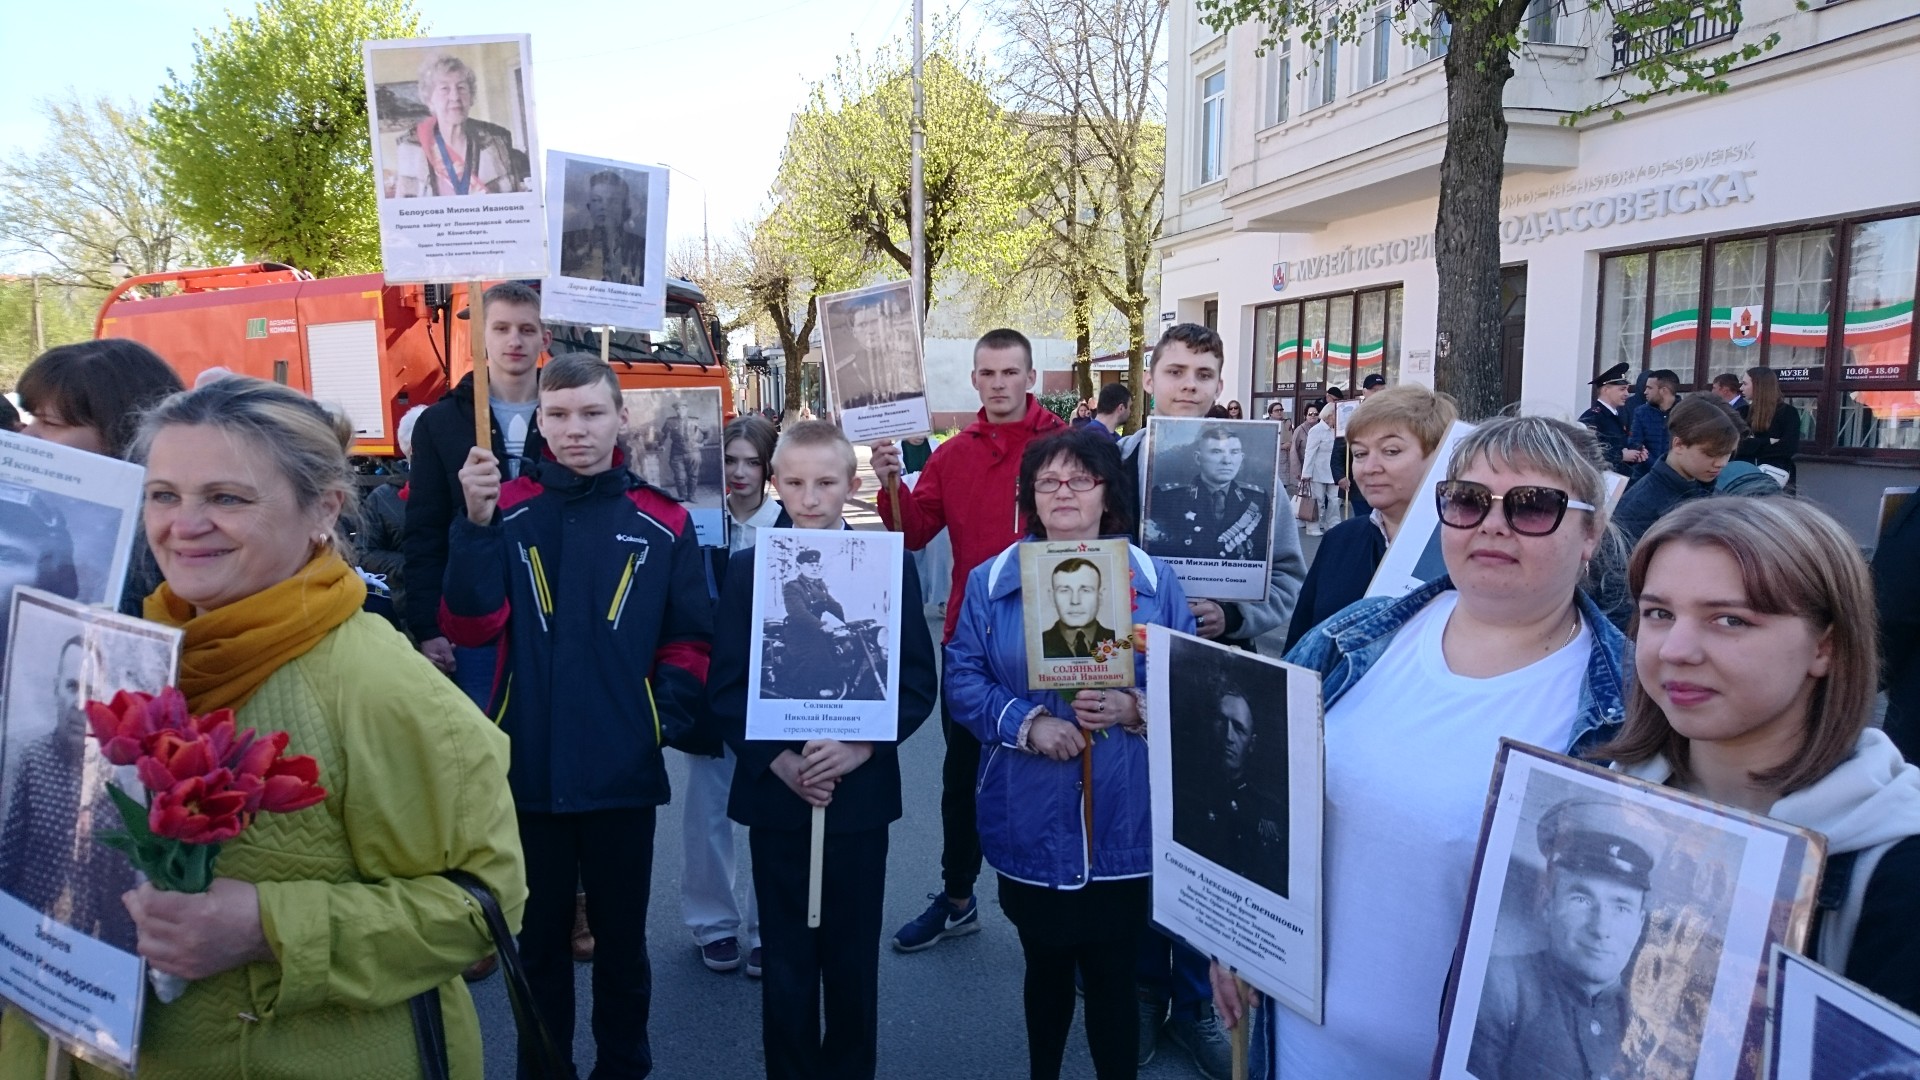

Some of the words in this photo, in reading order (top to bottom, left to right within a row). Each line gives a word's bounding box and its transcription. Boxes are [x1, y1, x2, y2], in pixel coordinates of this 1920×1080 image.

[1547, 184, 1572, 199] THE
[1577, 166, 1644, 194] HISTORY
[1647, 162, 1668, 179] OF
[1675, 141, 1756, 174] SOVETSK
[398, 208, 444, 217] Белоусова
[483, 204, 525, 212] Ивановна
[1296, 244, 1352, 282] МУЗЕЙ
[1354, 232, 1437, 271] ИСТОРИ
[1499, 207, 1564, 246] ОДА
[1570, 170, 1753, 232] СОВЕТСКА
[1779, 368, 1809, 377] МУЗЕЙ
[1, 456, 81, 484] Яковлевич
[622, 535, 648, 544] Columbia
[1186, 559, 1219, 567] Михаил
[1221, 561, 1263, 569] Иванович
[1053, 664, 1108, 673] СОЛЯНКИН
[1039, 673, 1077, 682] Николай
[1080, 672, 1124, 681] Иванович
[803, 701, 843, 709] Солянкин
[784, 713, 820, 721] Николай
[822, 713, 861, 722] Иванович
[783, 726, 860, 735] стрелок-артиллерист
[1165, 852, 1196, 877] Соколов
[1198, 872, 1243, 903] Александр
[1245, 897, 1304, 936] Степанович
[35, 954, 117, 1004] Никифорович
